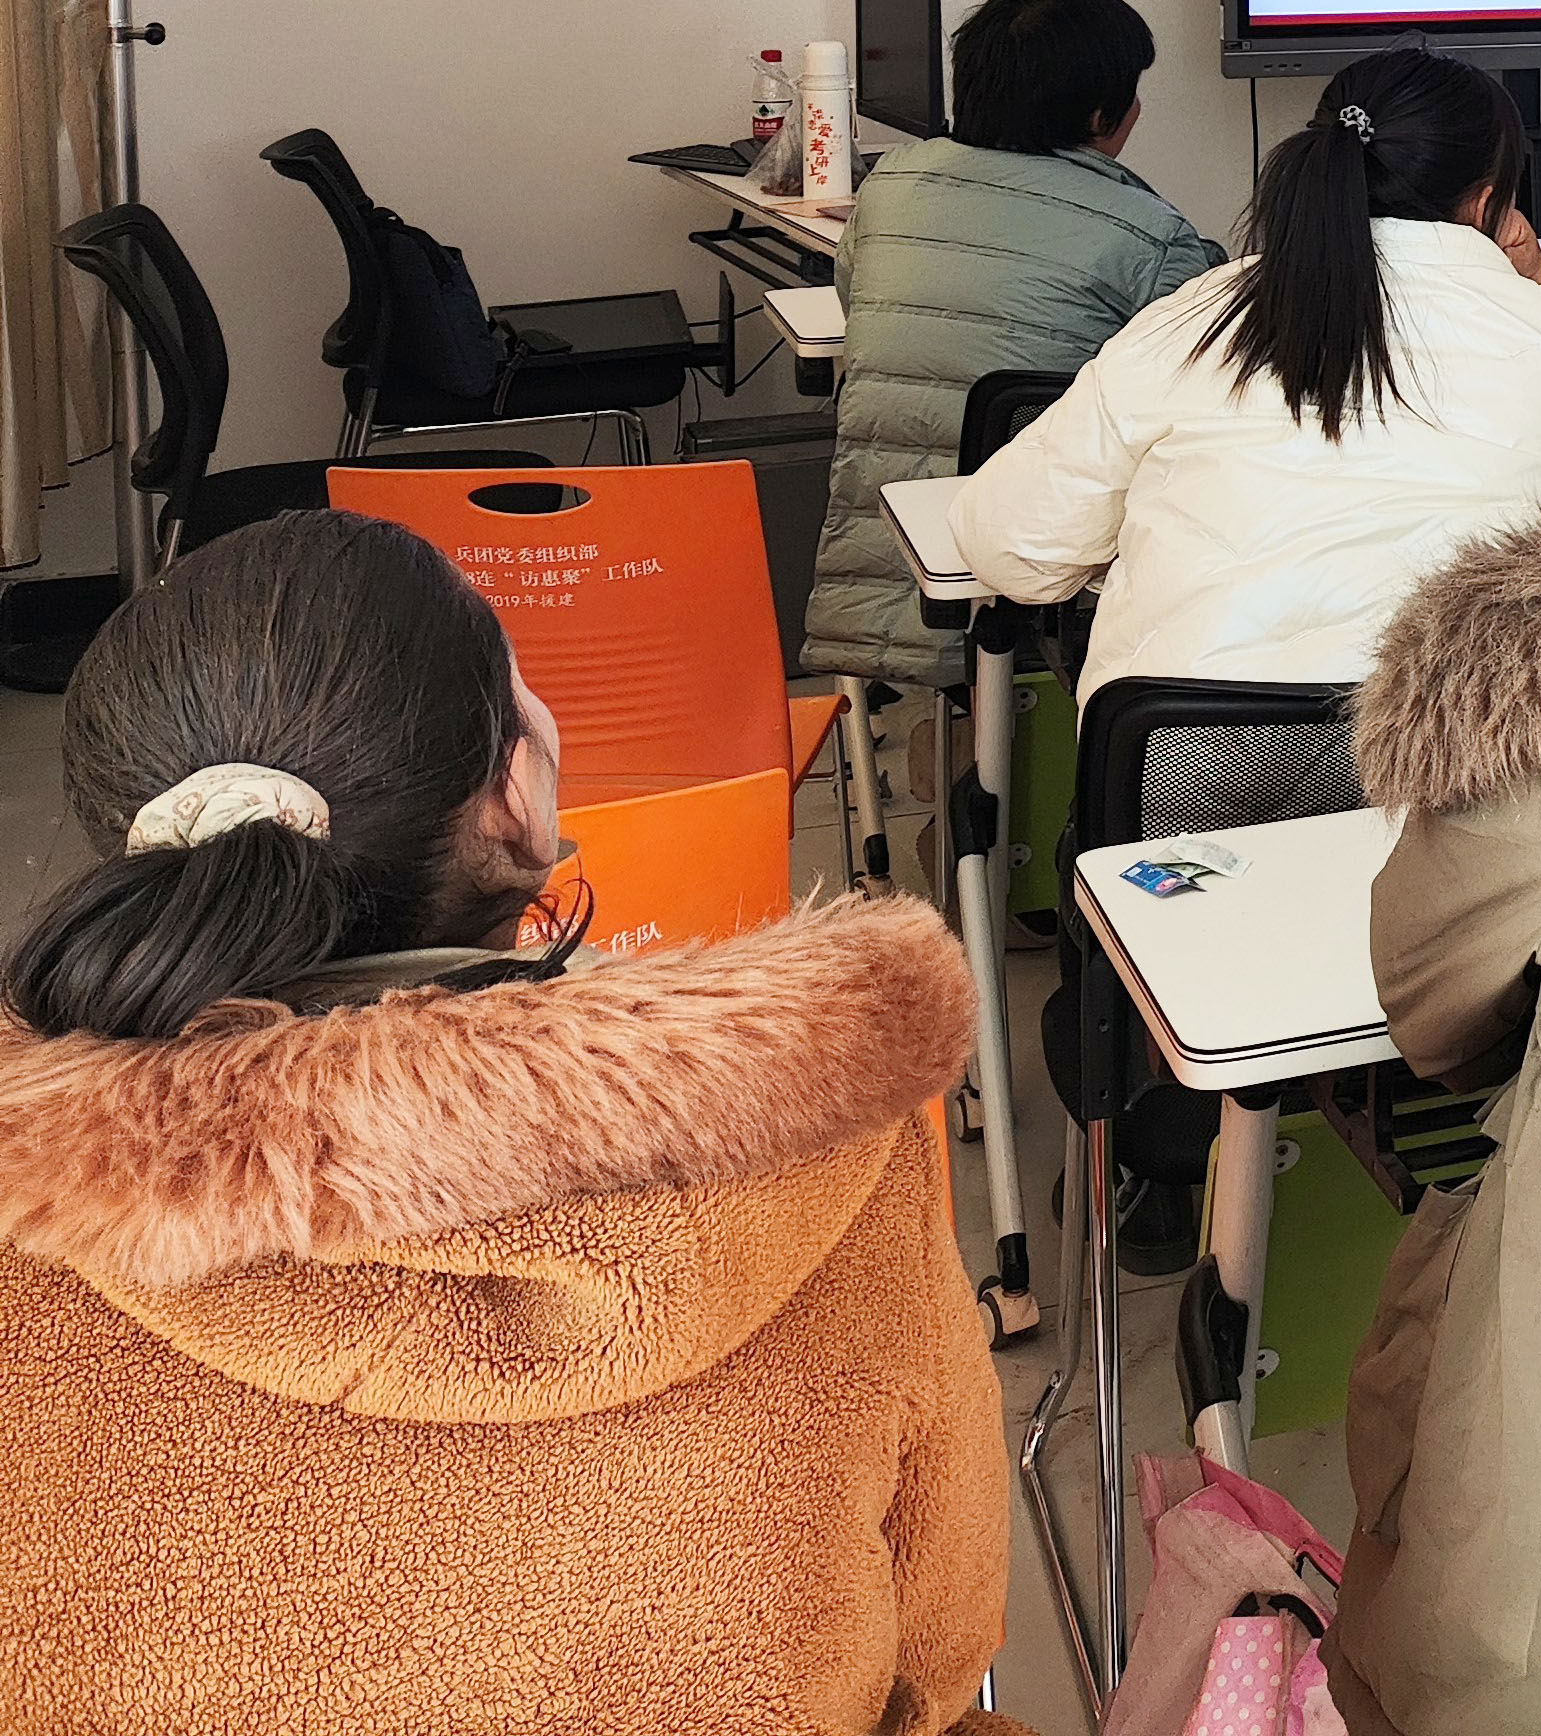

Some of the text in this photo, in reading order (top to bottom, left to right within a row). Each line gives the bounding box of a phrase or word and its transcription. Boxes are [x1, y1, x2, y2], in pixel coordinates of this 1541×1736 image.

[455, 543, 599, 564] 兵团党委组织部
